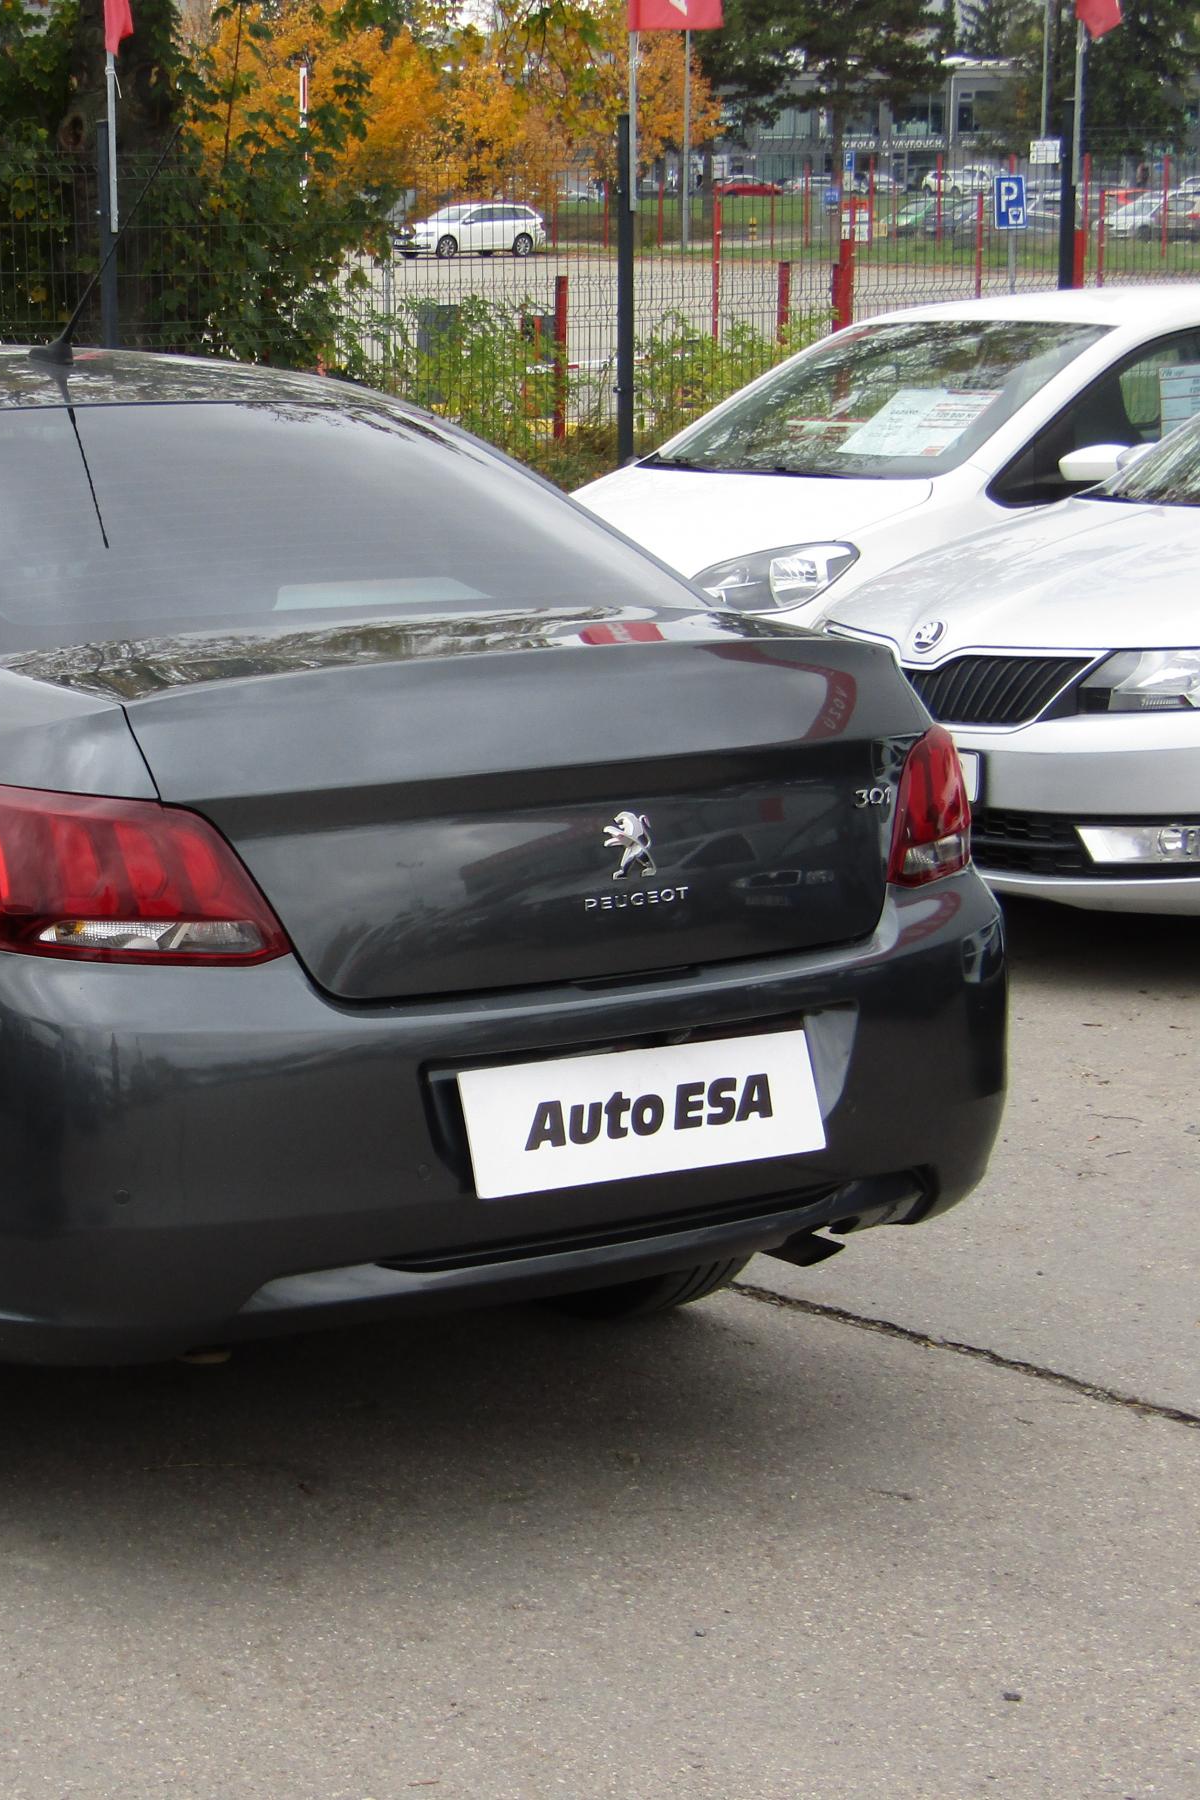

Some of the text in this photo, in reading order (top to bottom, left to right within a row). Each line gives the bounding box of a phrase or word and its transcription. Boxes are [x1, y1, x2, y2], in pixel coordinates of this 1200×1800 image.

[1000, 181, 1018, 213] P
[854, 786, 892, 808] 301
[584, 886, 689, 912] PEUGEOT
[524, 1073, 773, 1151] Auto ESA
